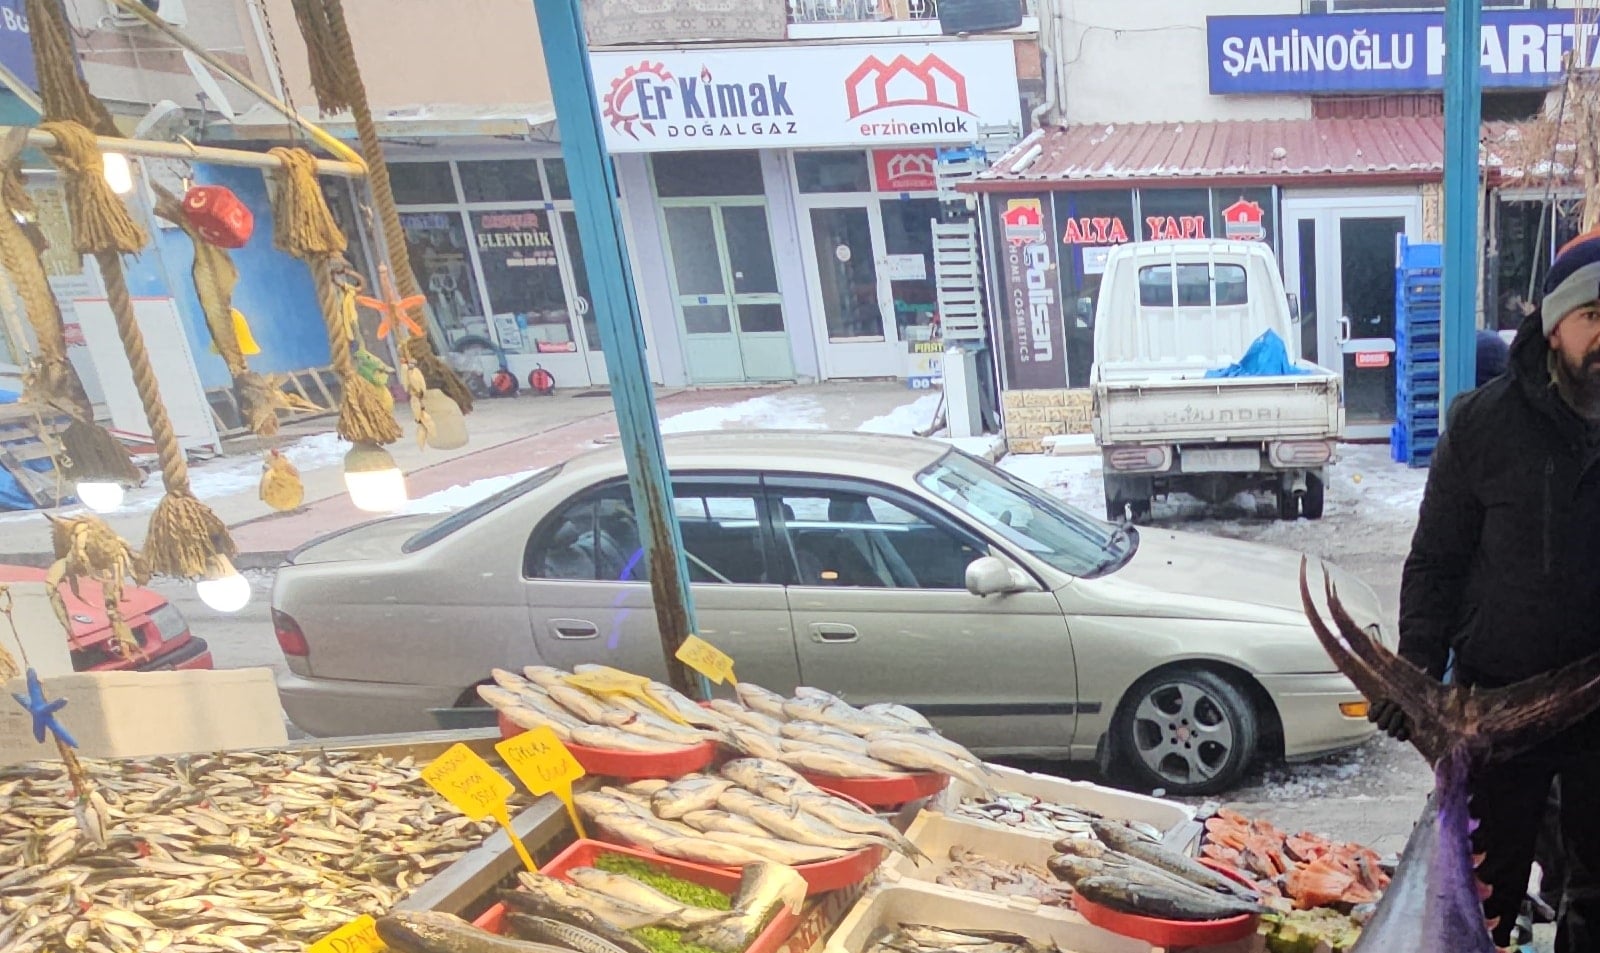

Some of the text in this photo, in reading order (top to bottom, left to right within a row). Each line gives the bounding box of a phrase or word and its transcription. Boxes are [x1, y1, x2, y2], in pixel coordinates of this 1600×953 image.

[1222, 29, 1414, 77] ŞAHİNOĞLU
[667, 120, 799, 138] DOĞALGAZ
[860, 116, 968, 136] erzinemlak
[477, 229, 554, 250] ELEKTRİK
[1063, 215, 1206, 244] ALYA YAPI
[1008, 244, 1031, 364] HOME COSMETICS
[1024, 243, 1054, 363] Polisan
